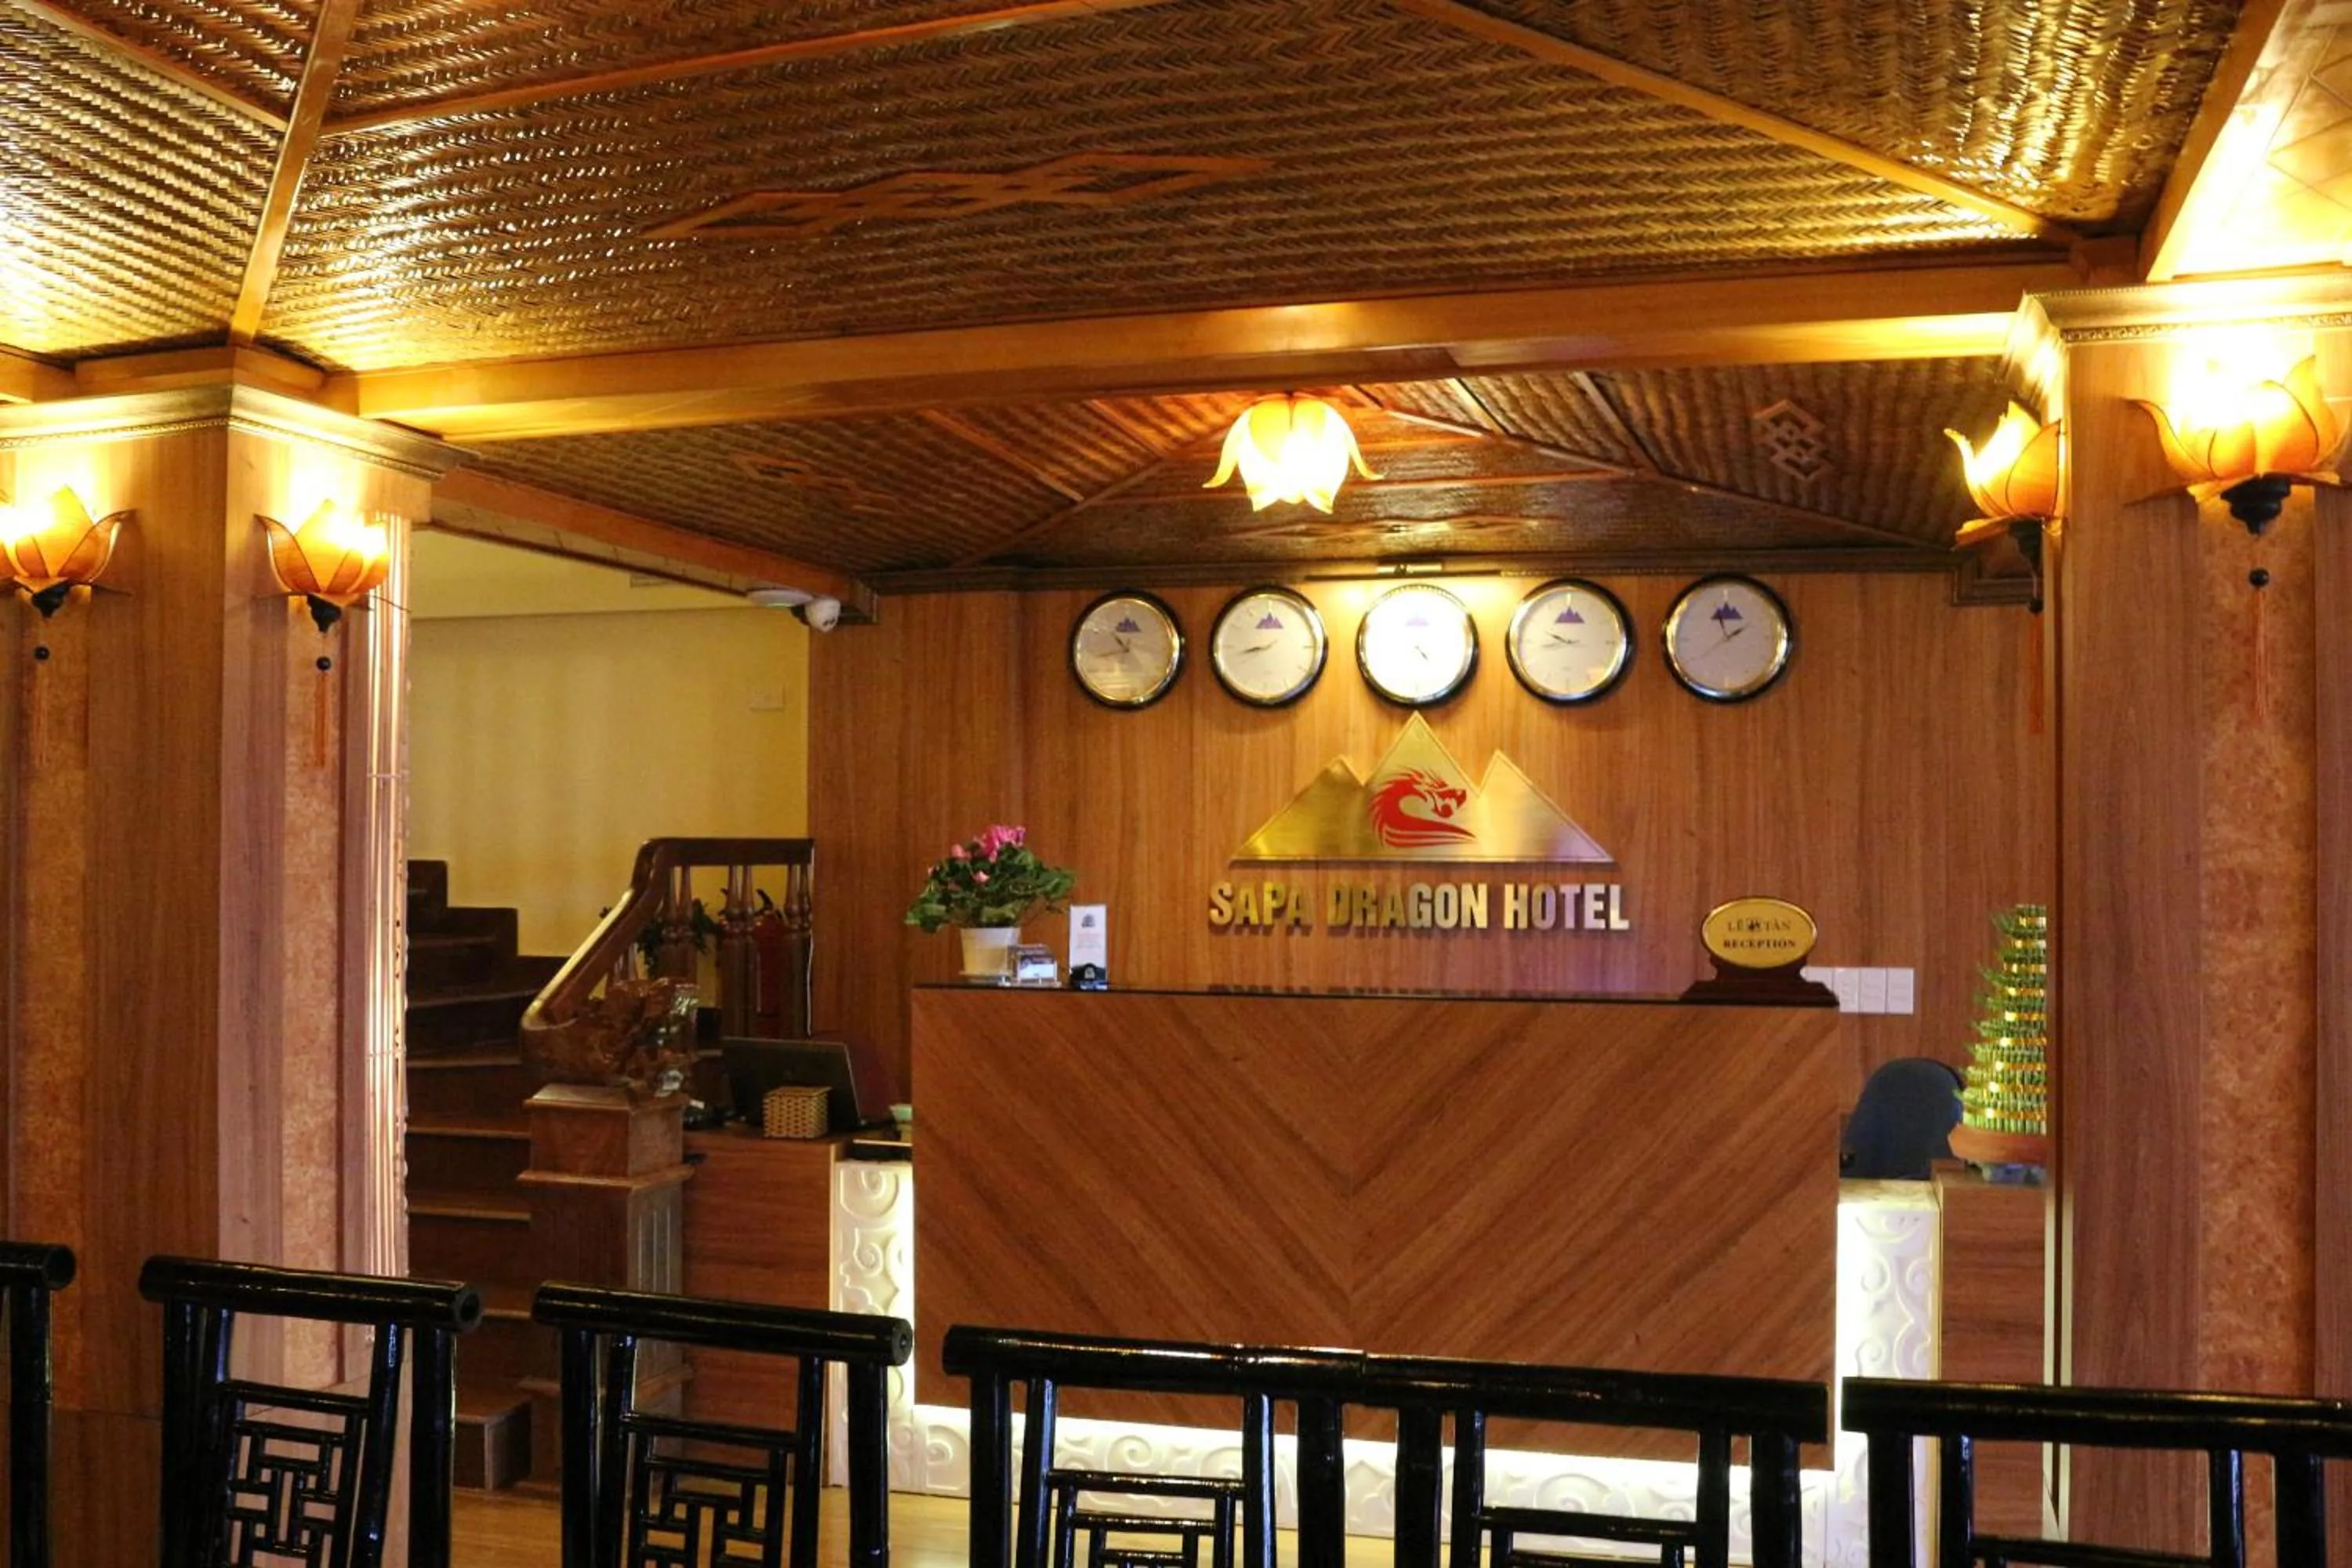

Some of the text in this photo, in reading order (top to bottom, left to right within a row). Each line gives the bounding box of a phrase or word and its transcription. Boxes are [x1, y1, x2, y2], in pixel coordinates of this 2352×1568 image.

[1210, 881, 1629, 931] SAPA DRAGON HOTEL
[1723, 939, 1796, 949] RECEPTION
